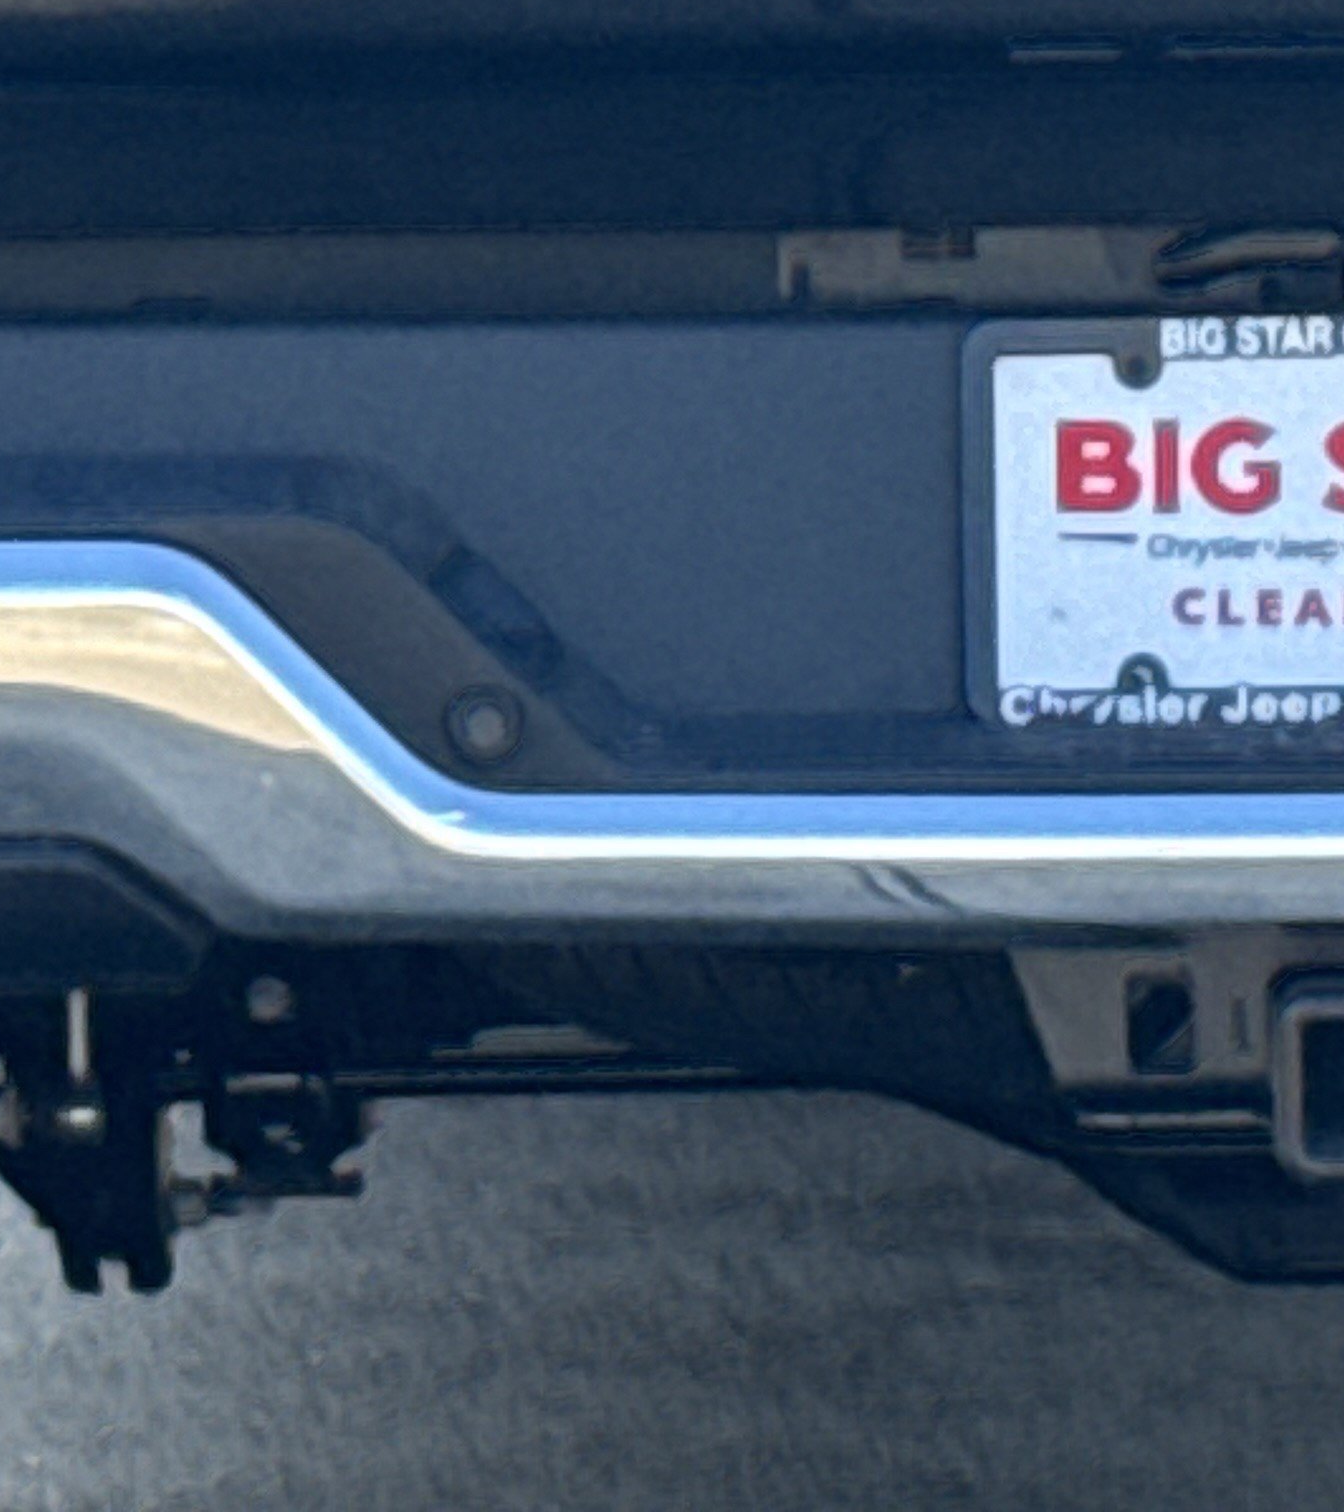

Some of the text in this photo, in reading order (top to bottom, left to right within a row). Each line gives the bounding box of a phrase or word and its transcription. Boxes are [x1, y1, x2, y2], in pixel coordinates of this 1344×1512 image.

[1159, 315, 1228, 358] BIG
[1234, 315, 1335, 356] STAR
[1055, 417, 1282, 516] BIG
